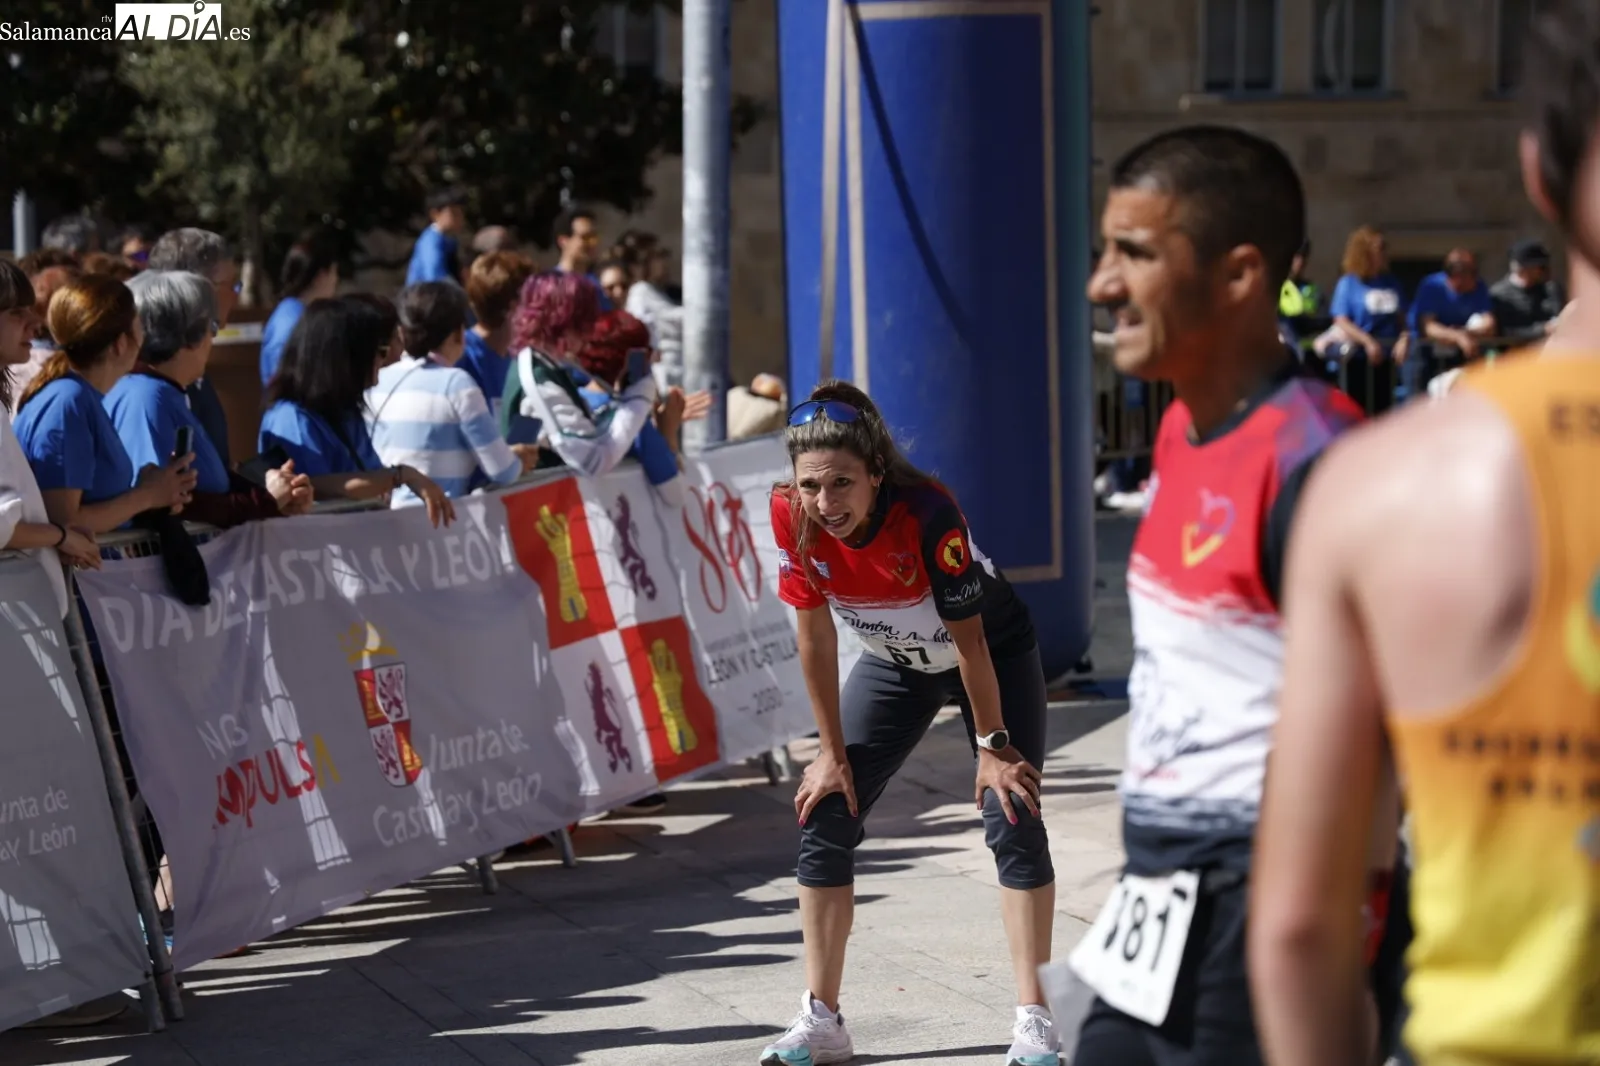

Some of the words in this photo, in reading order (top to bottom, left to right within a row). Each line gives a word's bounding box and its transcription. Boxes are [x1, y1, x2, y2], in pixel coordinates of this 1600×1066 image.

[204, 571, 245, 638] DE
[240, 543, 405, 614] ASTLA
[399, 542, 421, 593] Y
[884, 644, 932, 666] 67
[428, 725, 504, 774] Junta
[43, 785, 70, 814] de
[372, 788, 462, 848] Castla
[482, 766, 542, 816] León
[28, 822, 77, 855] León
